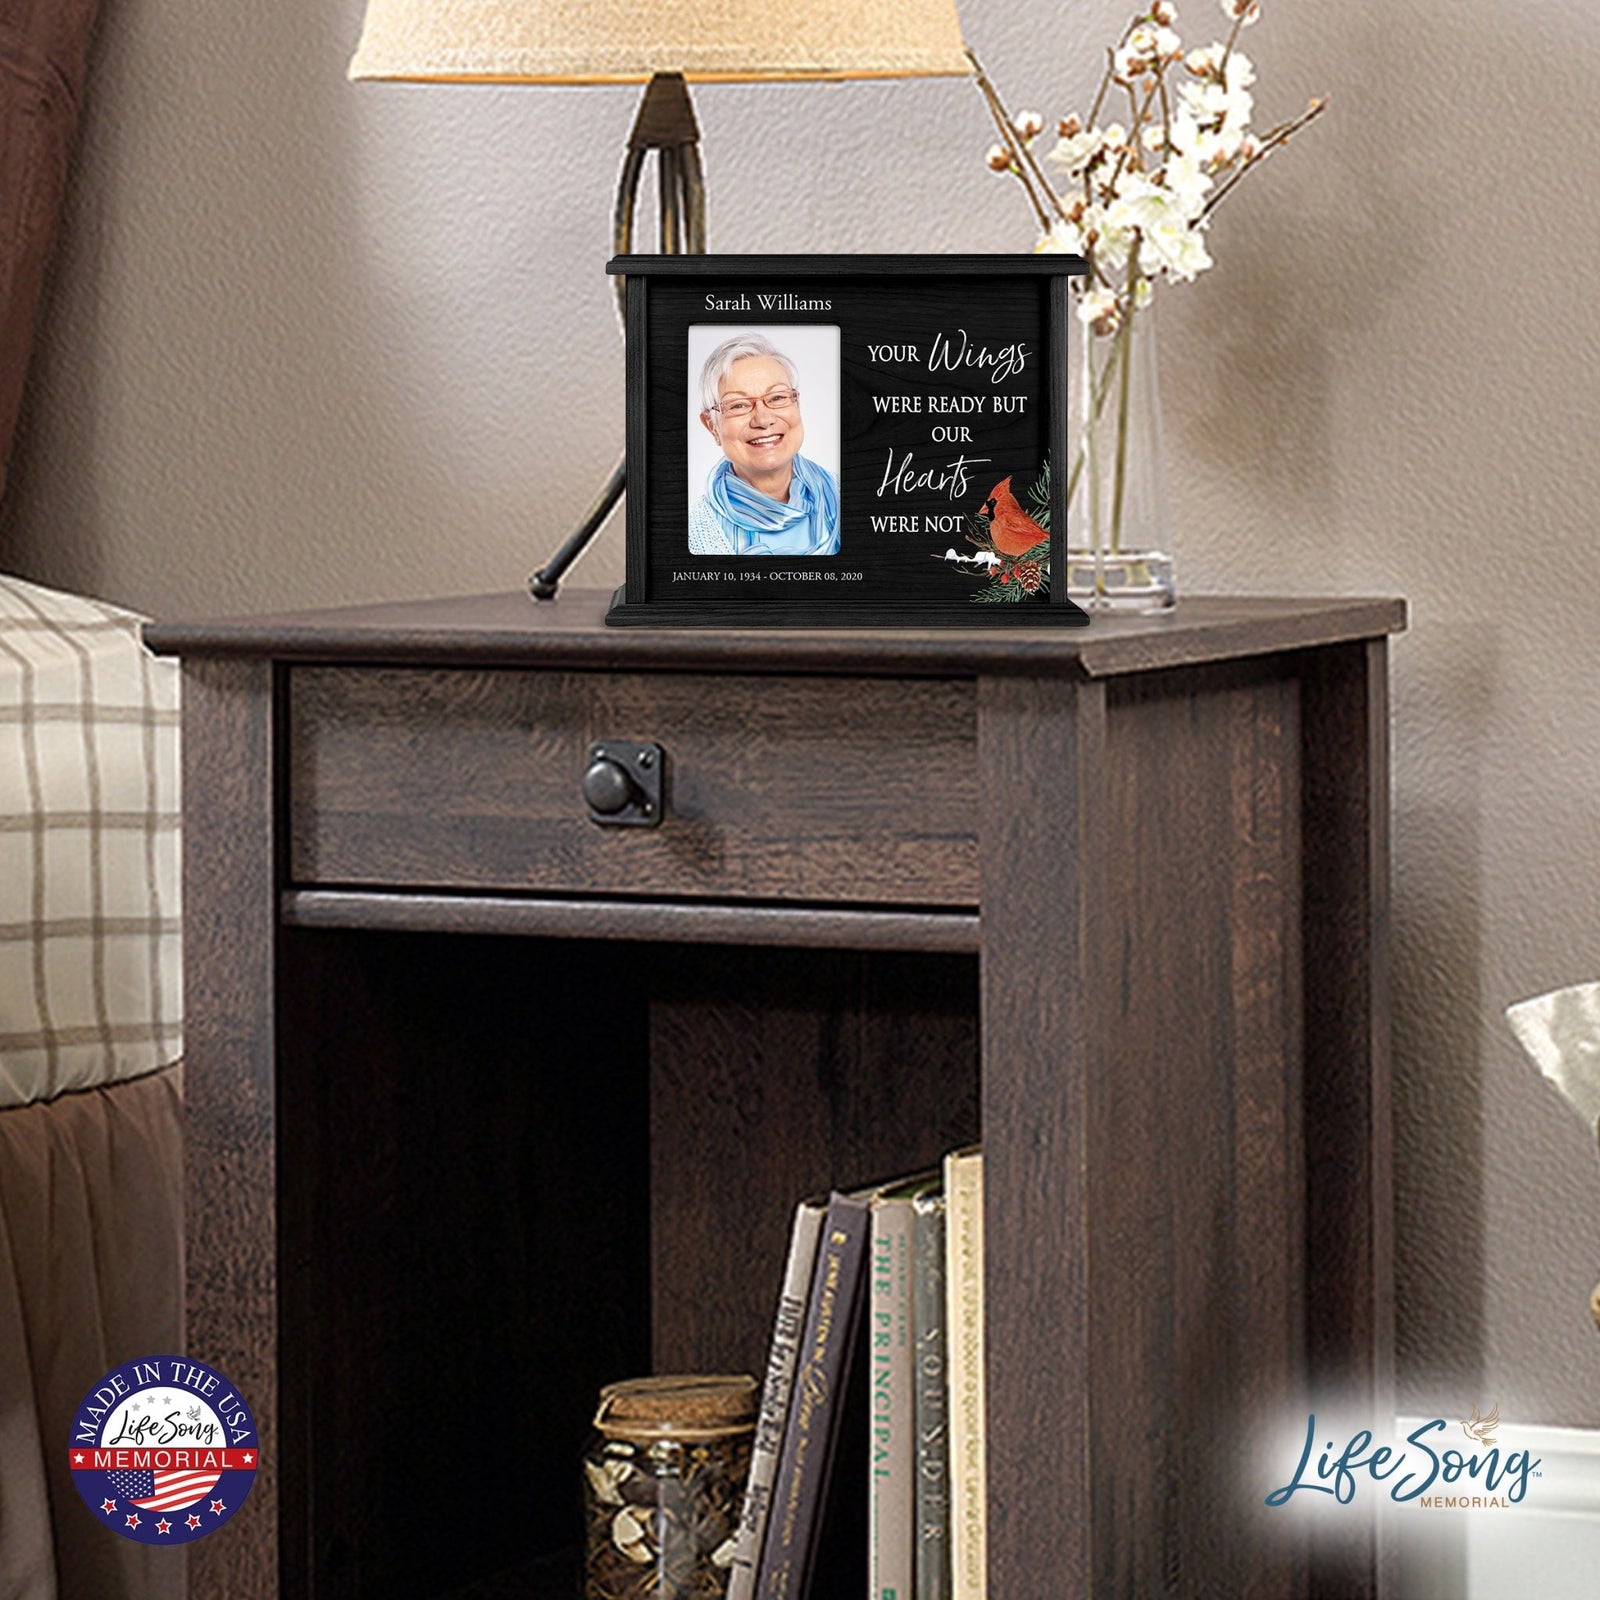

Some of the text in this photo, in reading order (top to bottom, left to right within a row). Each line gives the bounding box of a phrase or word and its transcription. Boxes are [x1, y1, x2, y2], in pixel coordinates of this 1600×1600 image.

[704, 293, 832, 311] Sarah Williams
[867, 328, 1033, 385] YOUR Wings
[871, 396, 1028, 414] WERE READY BUT
[931, 426, 974, 443] OUR
[876, 447, 992, 501] Hearts
[869, 515, 965, 533] WERE NOT
[672, 571, 721, 583] JANUARY
[723, 572, 737, 582] 10,
[740, 571, 761, 582] 1934
[769, 571, 823, 582] OCTOBER
[823, 572, 838, 582] 08,
[840, 572, 863, 582] 2020
[873, 1234, 893, 1480] THE PRINCIPAL
[922, 1327, 944, 1540] SOUNDER
